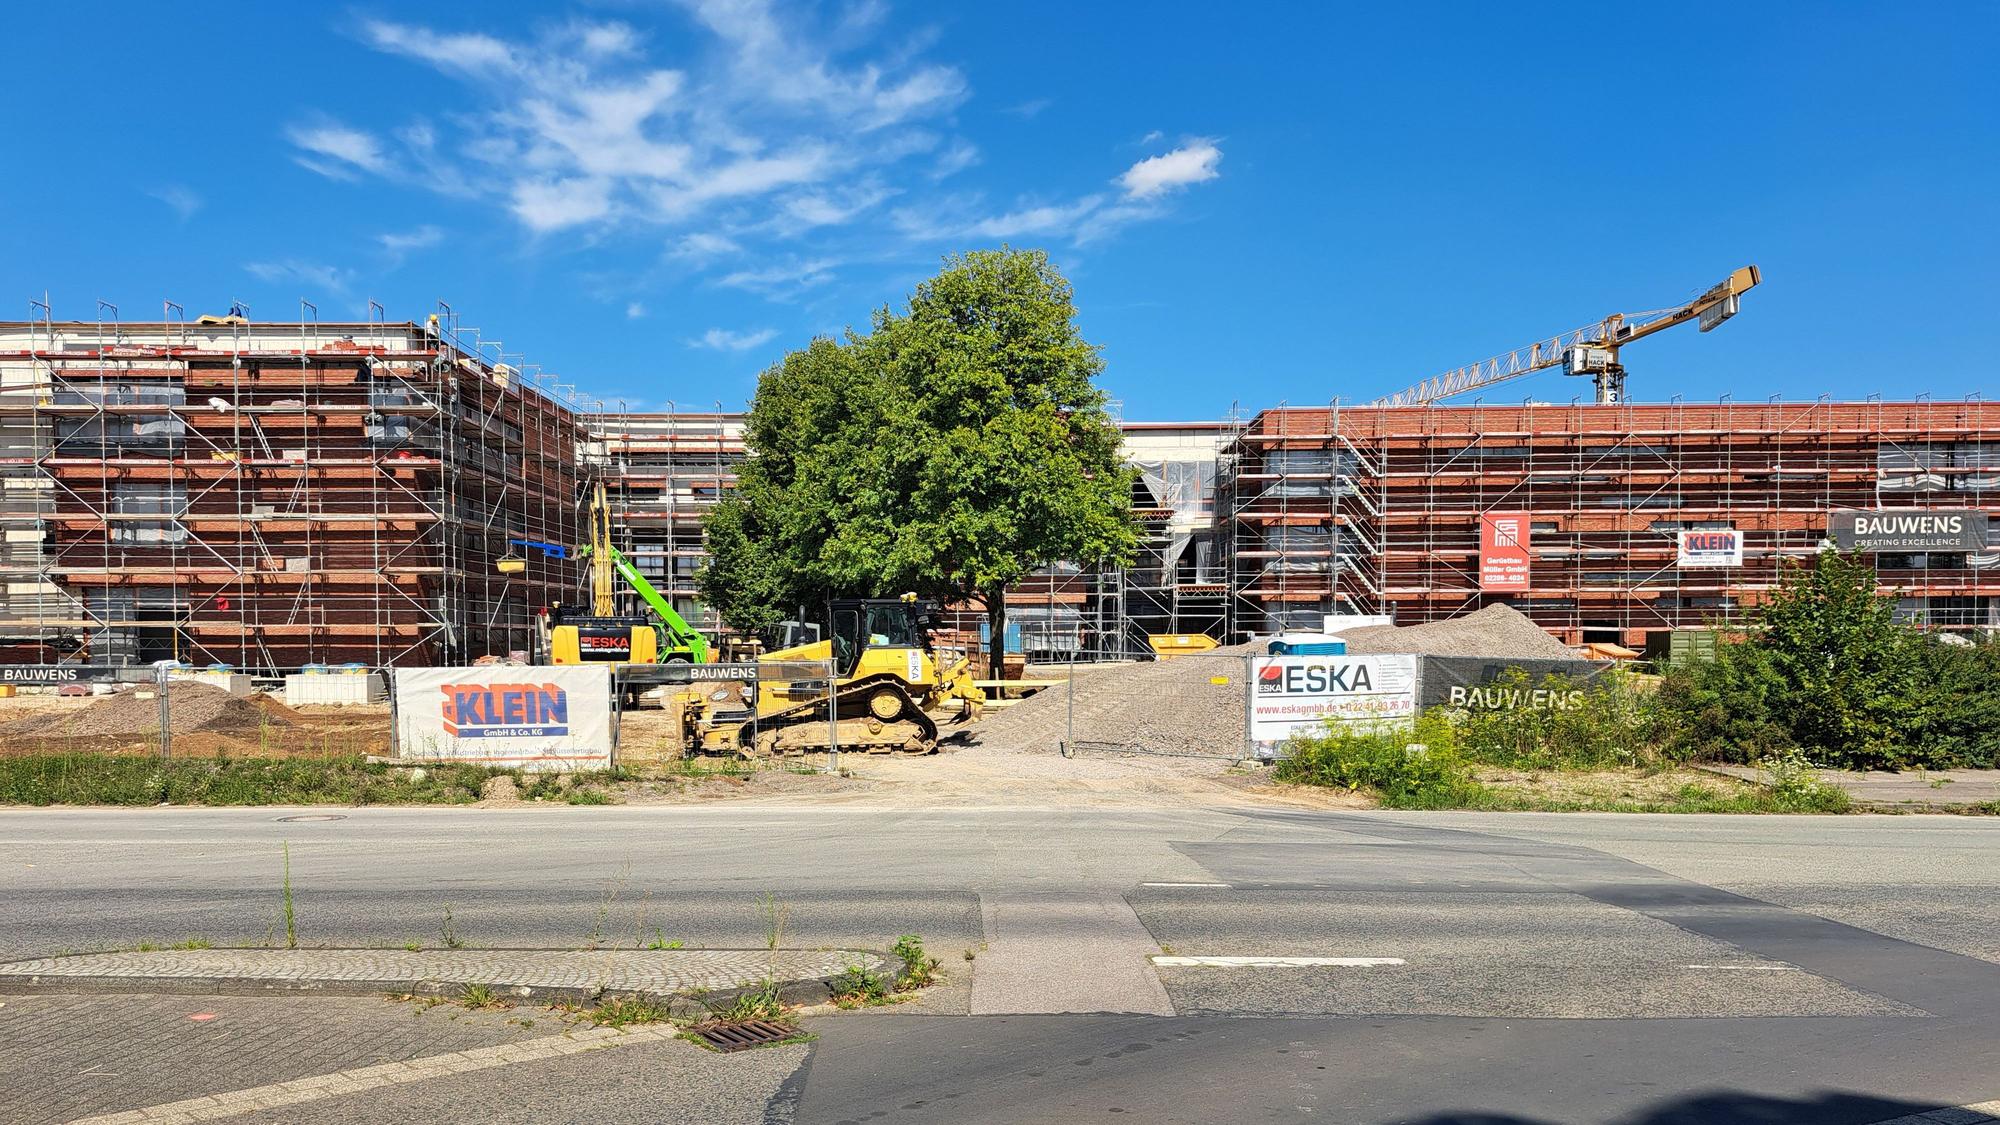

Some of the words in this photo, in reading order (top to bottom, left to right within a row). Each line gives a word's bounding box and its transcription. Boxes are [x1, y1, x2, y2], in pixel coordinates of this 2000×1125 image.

[1672, 308, 1694, 320] HACK
[1610, 393, 1618, 402] 3
[1855, 516, 1962, 534] BAUWENS
[1688, 536, 1736, 550] KLEIN
[1902, 538, 1960, 546] EXCELLENCE
[592, 637, 629, 647] ESKA
[690, 667, 756, 679] BAUWENS
[911, 656, 919, 679] ESKA
[4, 669, 77, 680] BAUWENS
[1286, 664, 1372, 693] ESKA
[1260, 684, 1282, 692] ESKA
[1450, 686, 1584, 710] BAUWENS
[455, 690, 568, 725] KLEIN
[1256, 703, 1337, 715] www.eskagmbh.de
[1401, 700, 1410, 709] 70
[531, 728, 543, 736] KG
